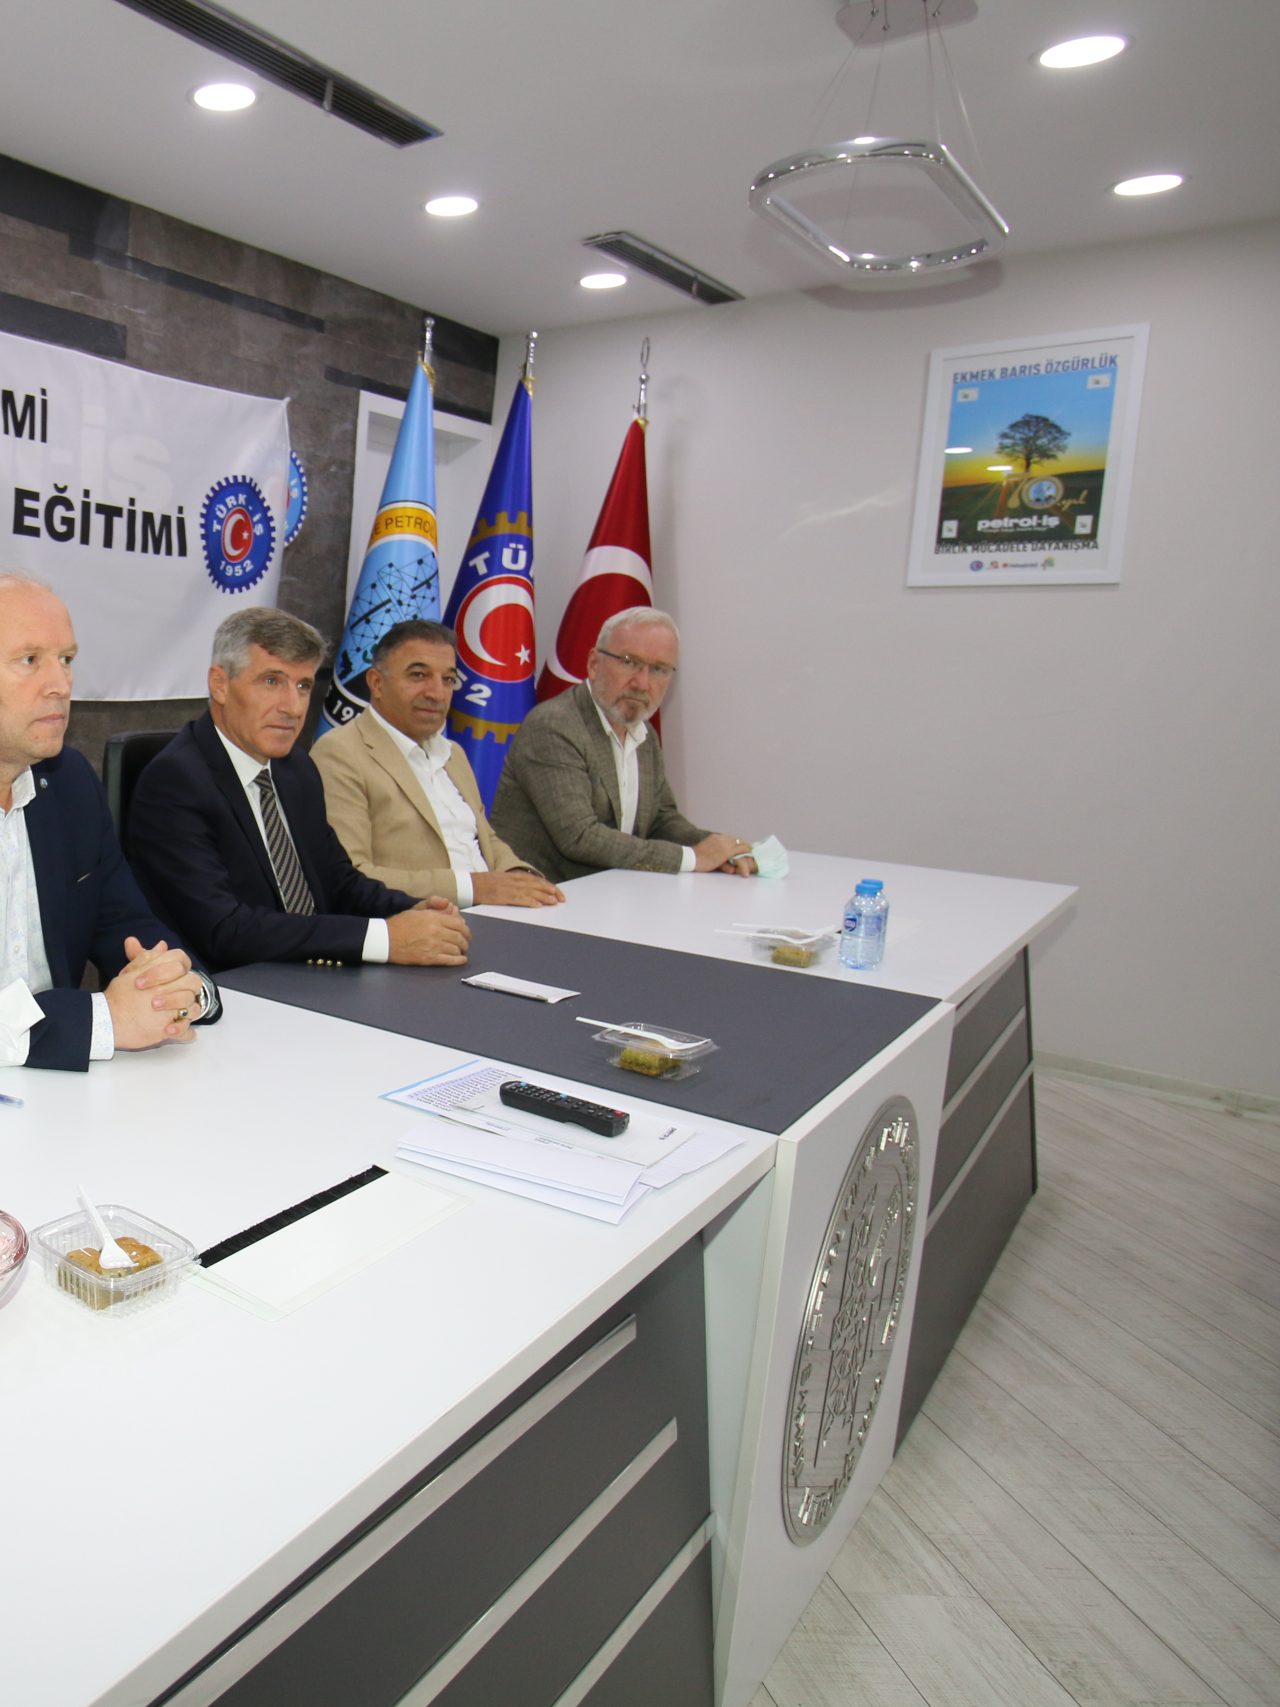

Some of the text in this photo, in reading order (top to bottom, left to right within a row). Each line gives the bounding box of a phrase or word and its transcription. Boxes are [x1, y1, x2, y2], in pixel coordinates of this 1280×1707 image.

[952, 369, 996, 385] EKMEK
[1044, 351, 1119, 374] ÖZGÜRLÜK
[13, 484, 187, 557] EĞİTİMİ
[219, 559, 254, 576] 1952
